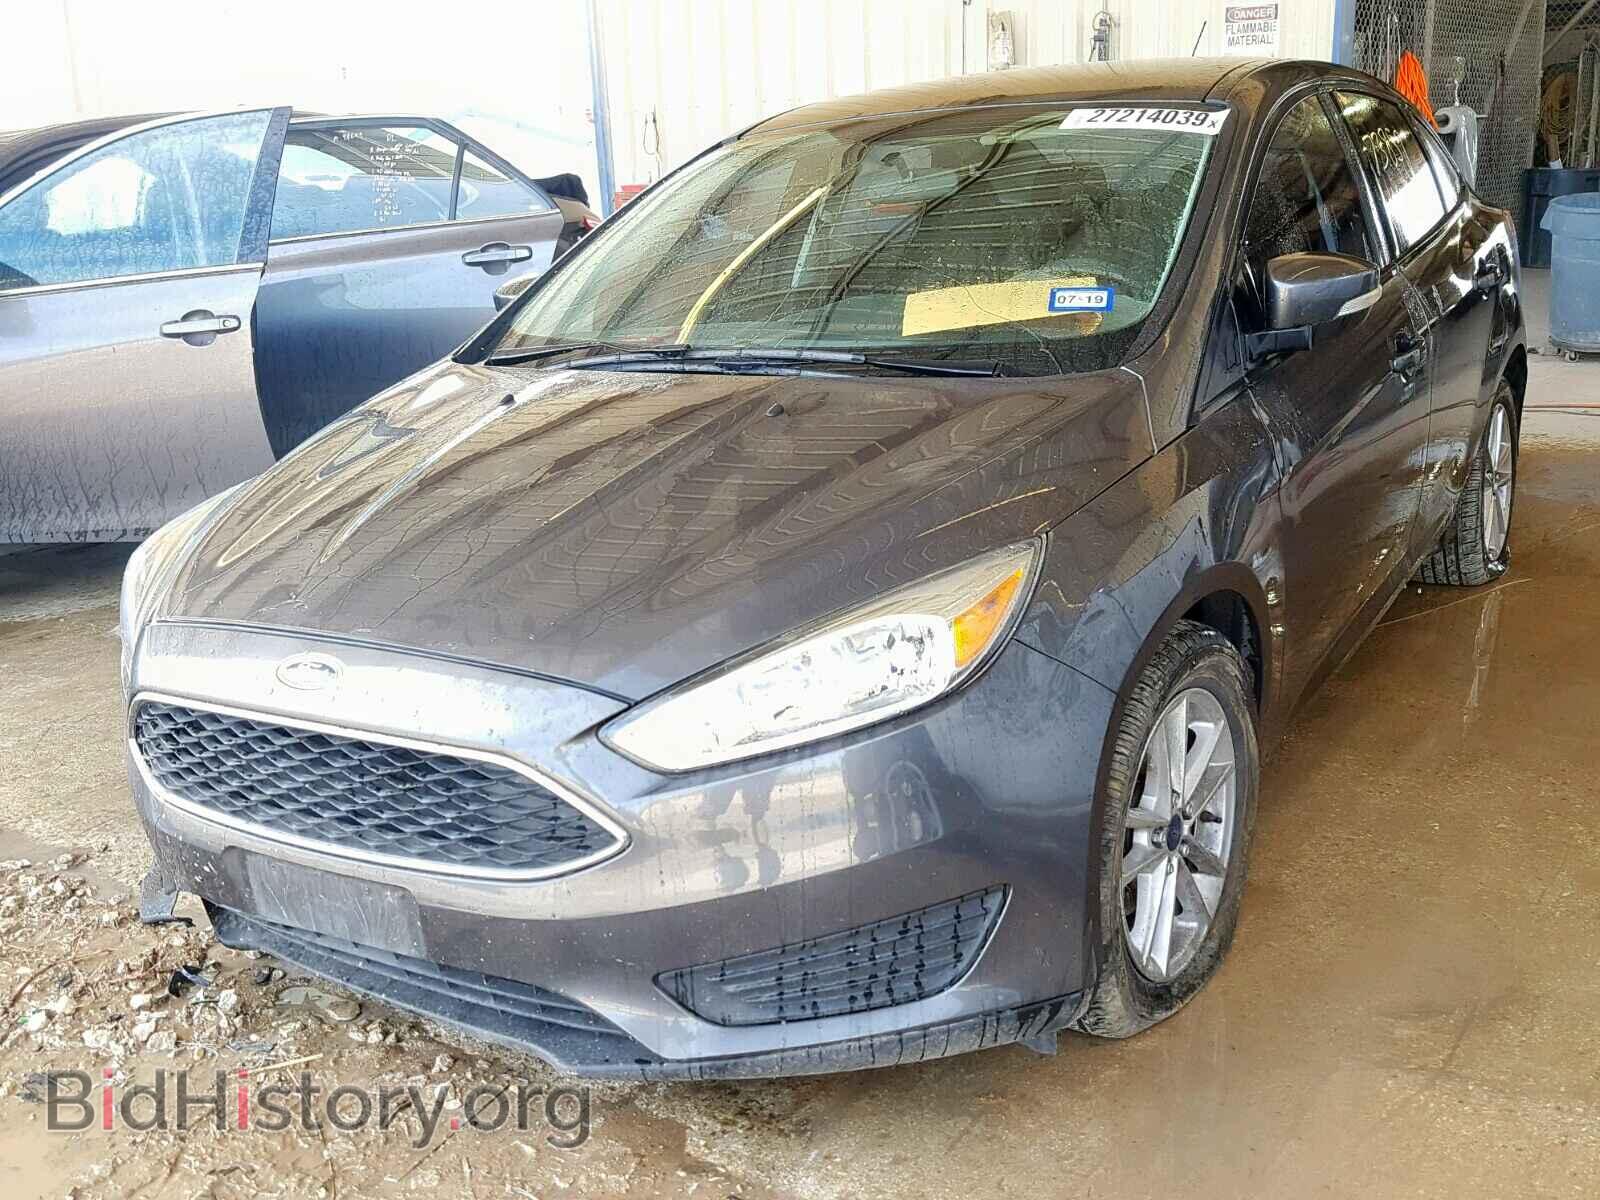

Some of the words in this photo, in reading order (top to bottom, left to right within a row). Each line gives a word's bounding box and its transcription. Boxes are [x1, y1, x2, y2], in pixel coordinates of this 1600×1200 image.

[1232, 7, 1273, 19] DANGER
[1086, 109, 1209, 127] 27214039
[1057, 295, 1104, 304] 07-19
